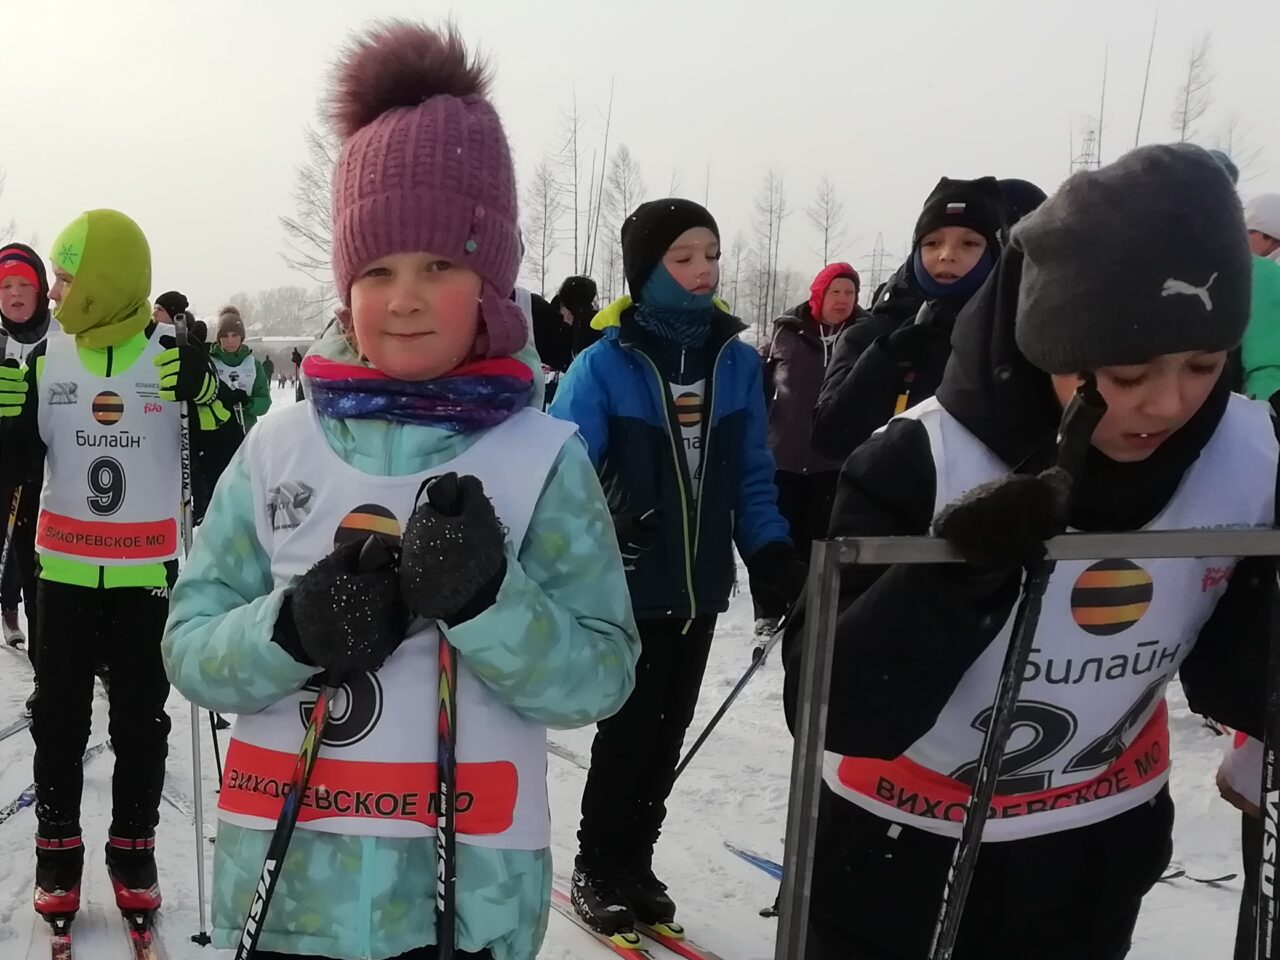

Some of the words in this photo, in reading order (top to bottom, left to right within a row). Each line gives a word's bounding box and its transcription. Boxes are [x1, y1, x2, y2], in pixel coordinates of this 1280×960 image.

[75, 430, 141, 448] Билайн
[181, 424, 191, 490] NORDWAY
[86, 456, 127, 517] 9
[146, 534, 165, 546] МО
[1019, 639, 1181, 685] Билайн
[1134, 740, 1161, 780] МО
[242, 859, 277, 949] VISU
